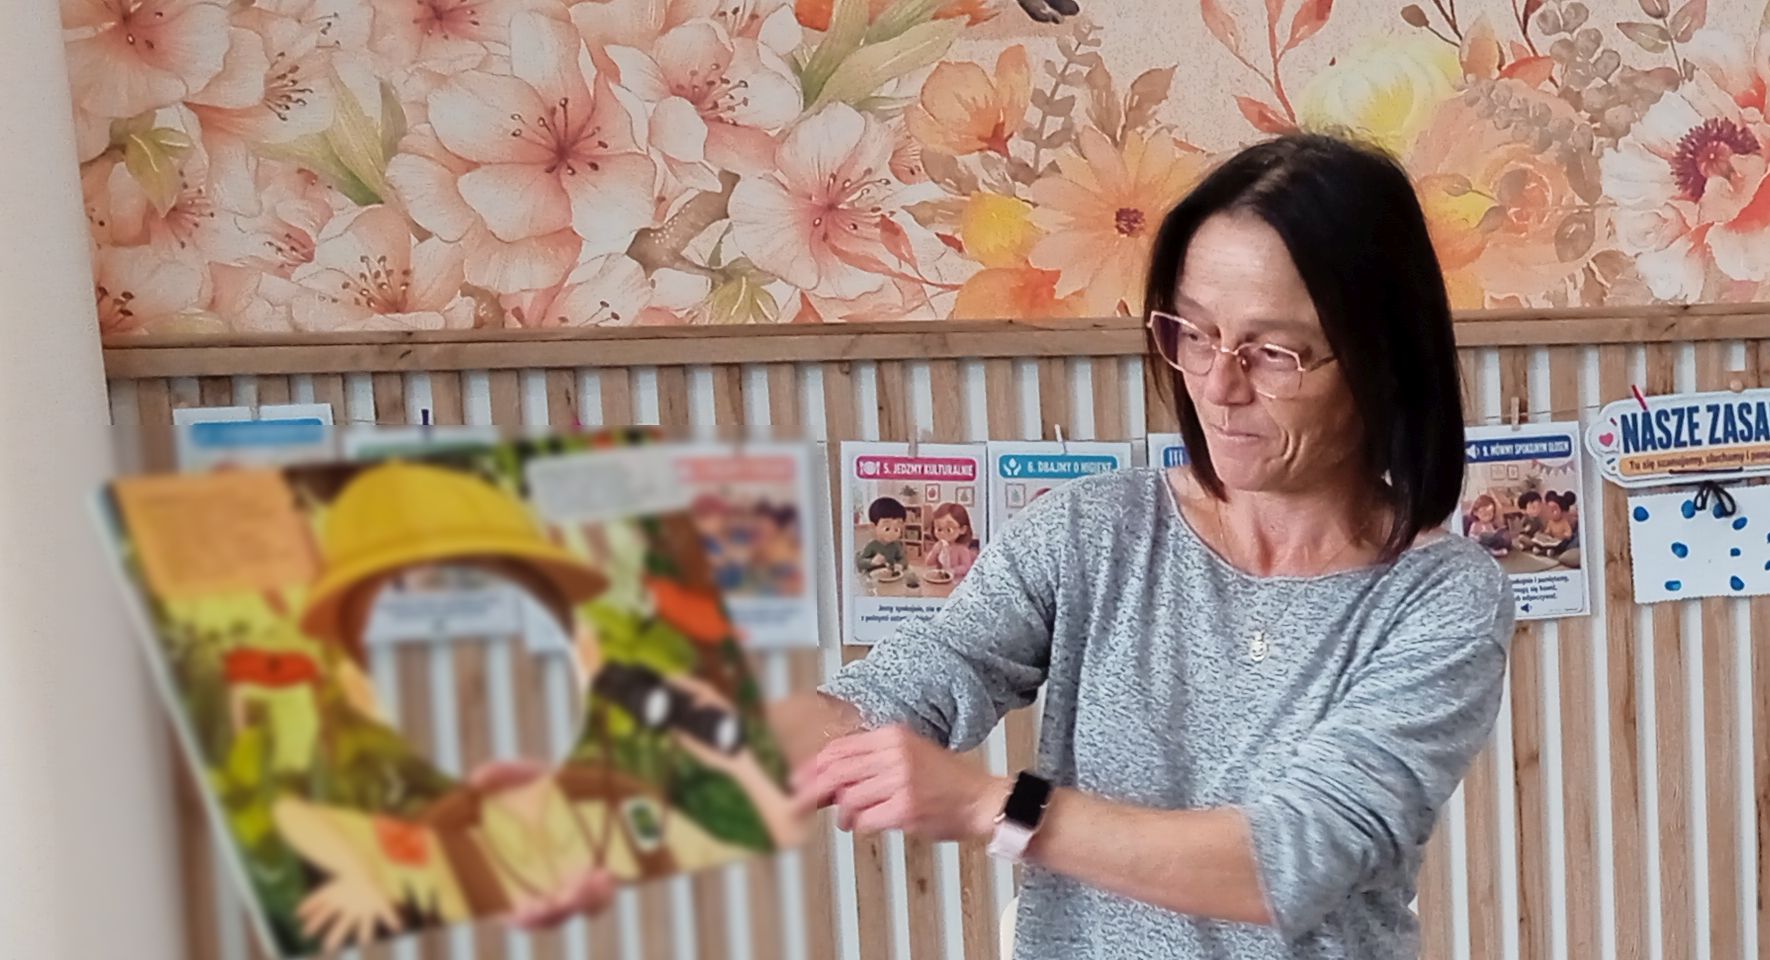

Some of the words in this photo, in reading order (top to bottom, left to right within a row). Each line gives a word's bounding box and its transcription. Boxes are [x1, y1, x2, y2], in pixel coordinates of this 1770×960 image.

[1620, 405, 1703, 454] NASZE
[1629, 460, 1641, 471] Tu
[1642, 460, 1655, 471] się
